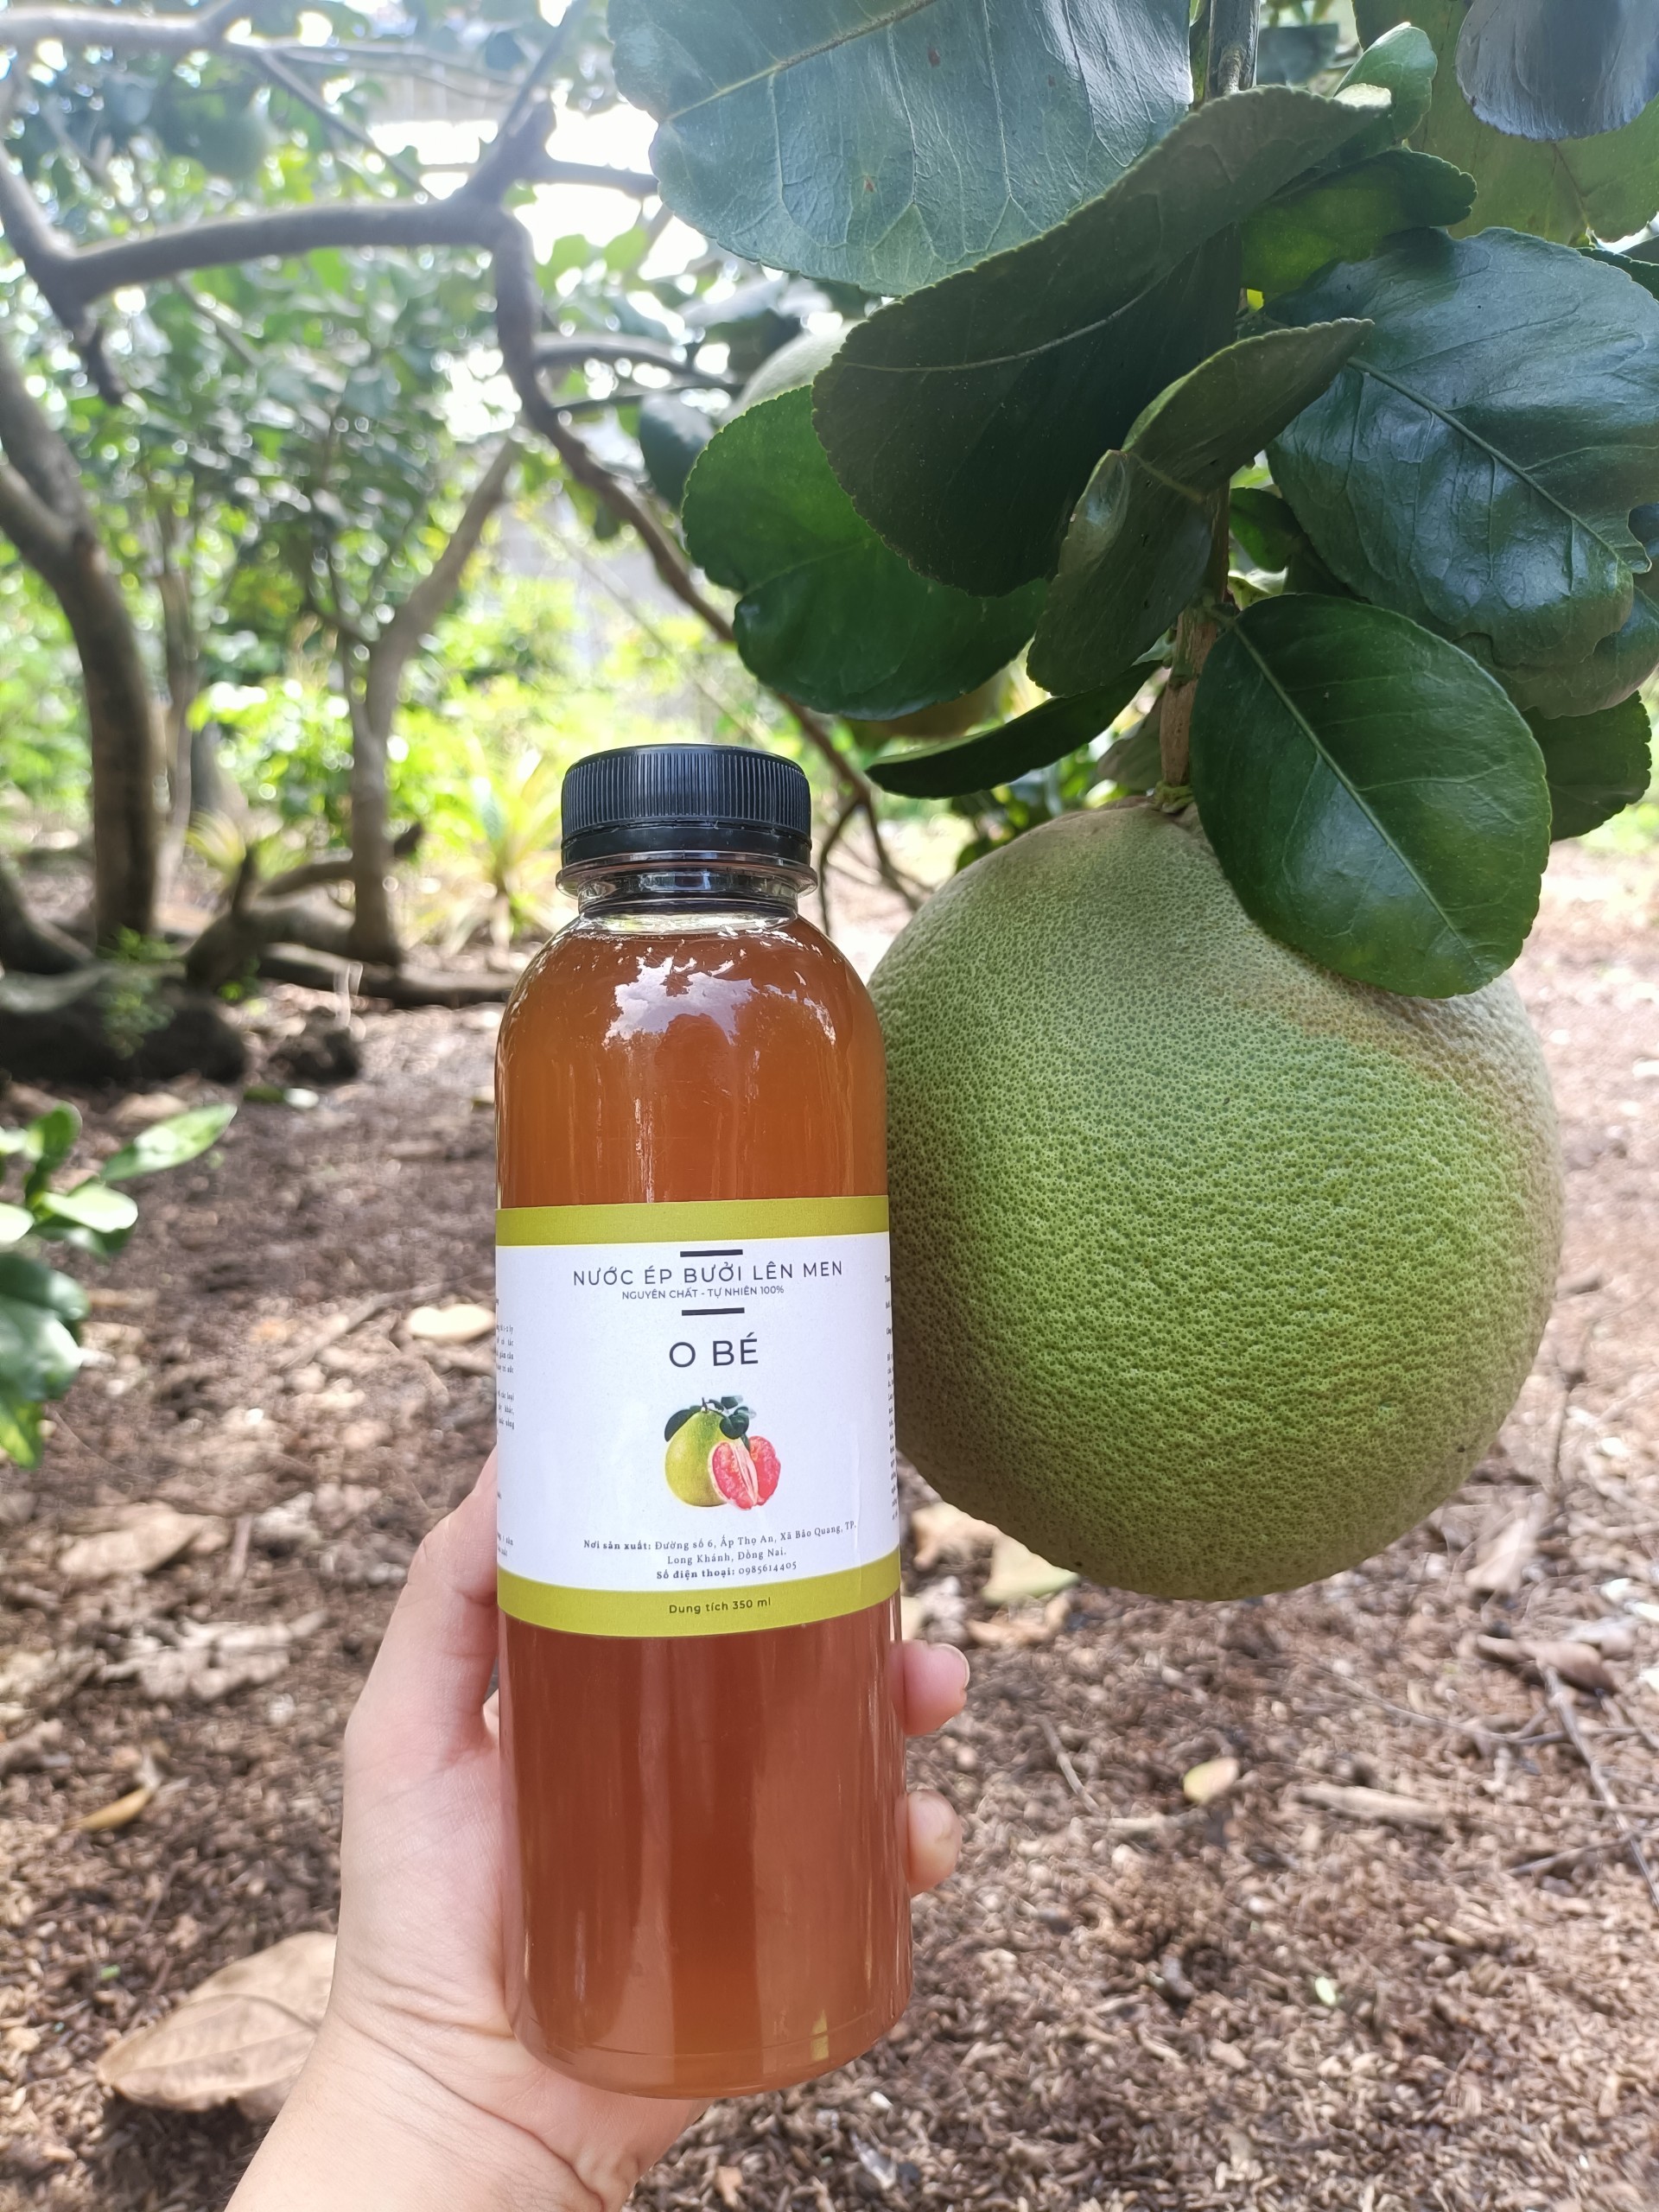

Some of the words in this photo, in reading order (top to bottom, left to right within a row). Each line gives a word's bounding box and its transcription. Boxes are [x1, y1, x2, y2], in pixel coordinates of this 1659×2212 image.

[573, 1266, 633, 1287] NƯỚC
[644, 1264, 672, 1285] ÉP
[683, 1261, 741, 1284] BƯỞI
[753, 1261, 793, 1281] LÊN
[803, 1260, 842, 1278] MEN
[621, 1288, 666, 1300] NGUYÊN
[669, 1286, 699, 1299] CHẤT
[707, 1287, 722, 1300] TỰ
[724, 1285, 758, 1297] NHIÊN
[760, 1285, 785, 1295] 100%
[669, 1341, 696, 1369] O
[712, 1332, 759, 1367] BÉ
[583, 1539, 601, 1549] Nơi
[602, 1541, 620, 1550] sản
[654, 1541, 690, 1552] Đường
[692, 1537, 704, 1549] số
[737, 1535, 757, 1547] Thọ
[667, 1555, 693, 1567] Long
[696, 1552, 734, 1563] Khánh,
[656, 1568, 670, 1580] Số
[672, 1569, 698, 1581] điện
[738, 1560, 797, 1576] 0985614405
[669, 1604, 702, 1615] Dung
[705, 1601, 728, 1612] tích
[732, 1599, 753, 1611] 350
[757, 1596, 771, 1608] ml
